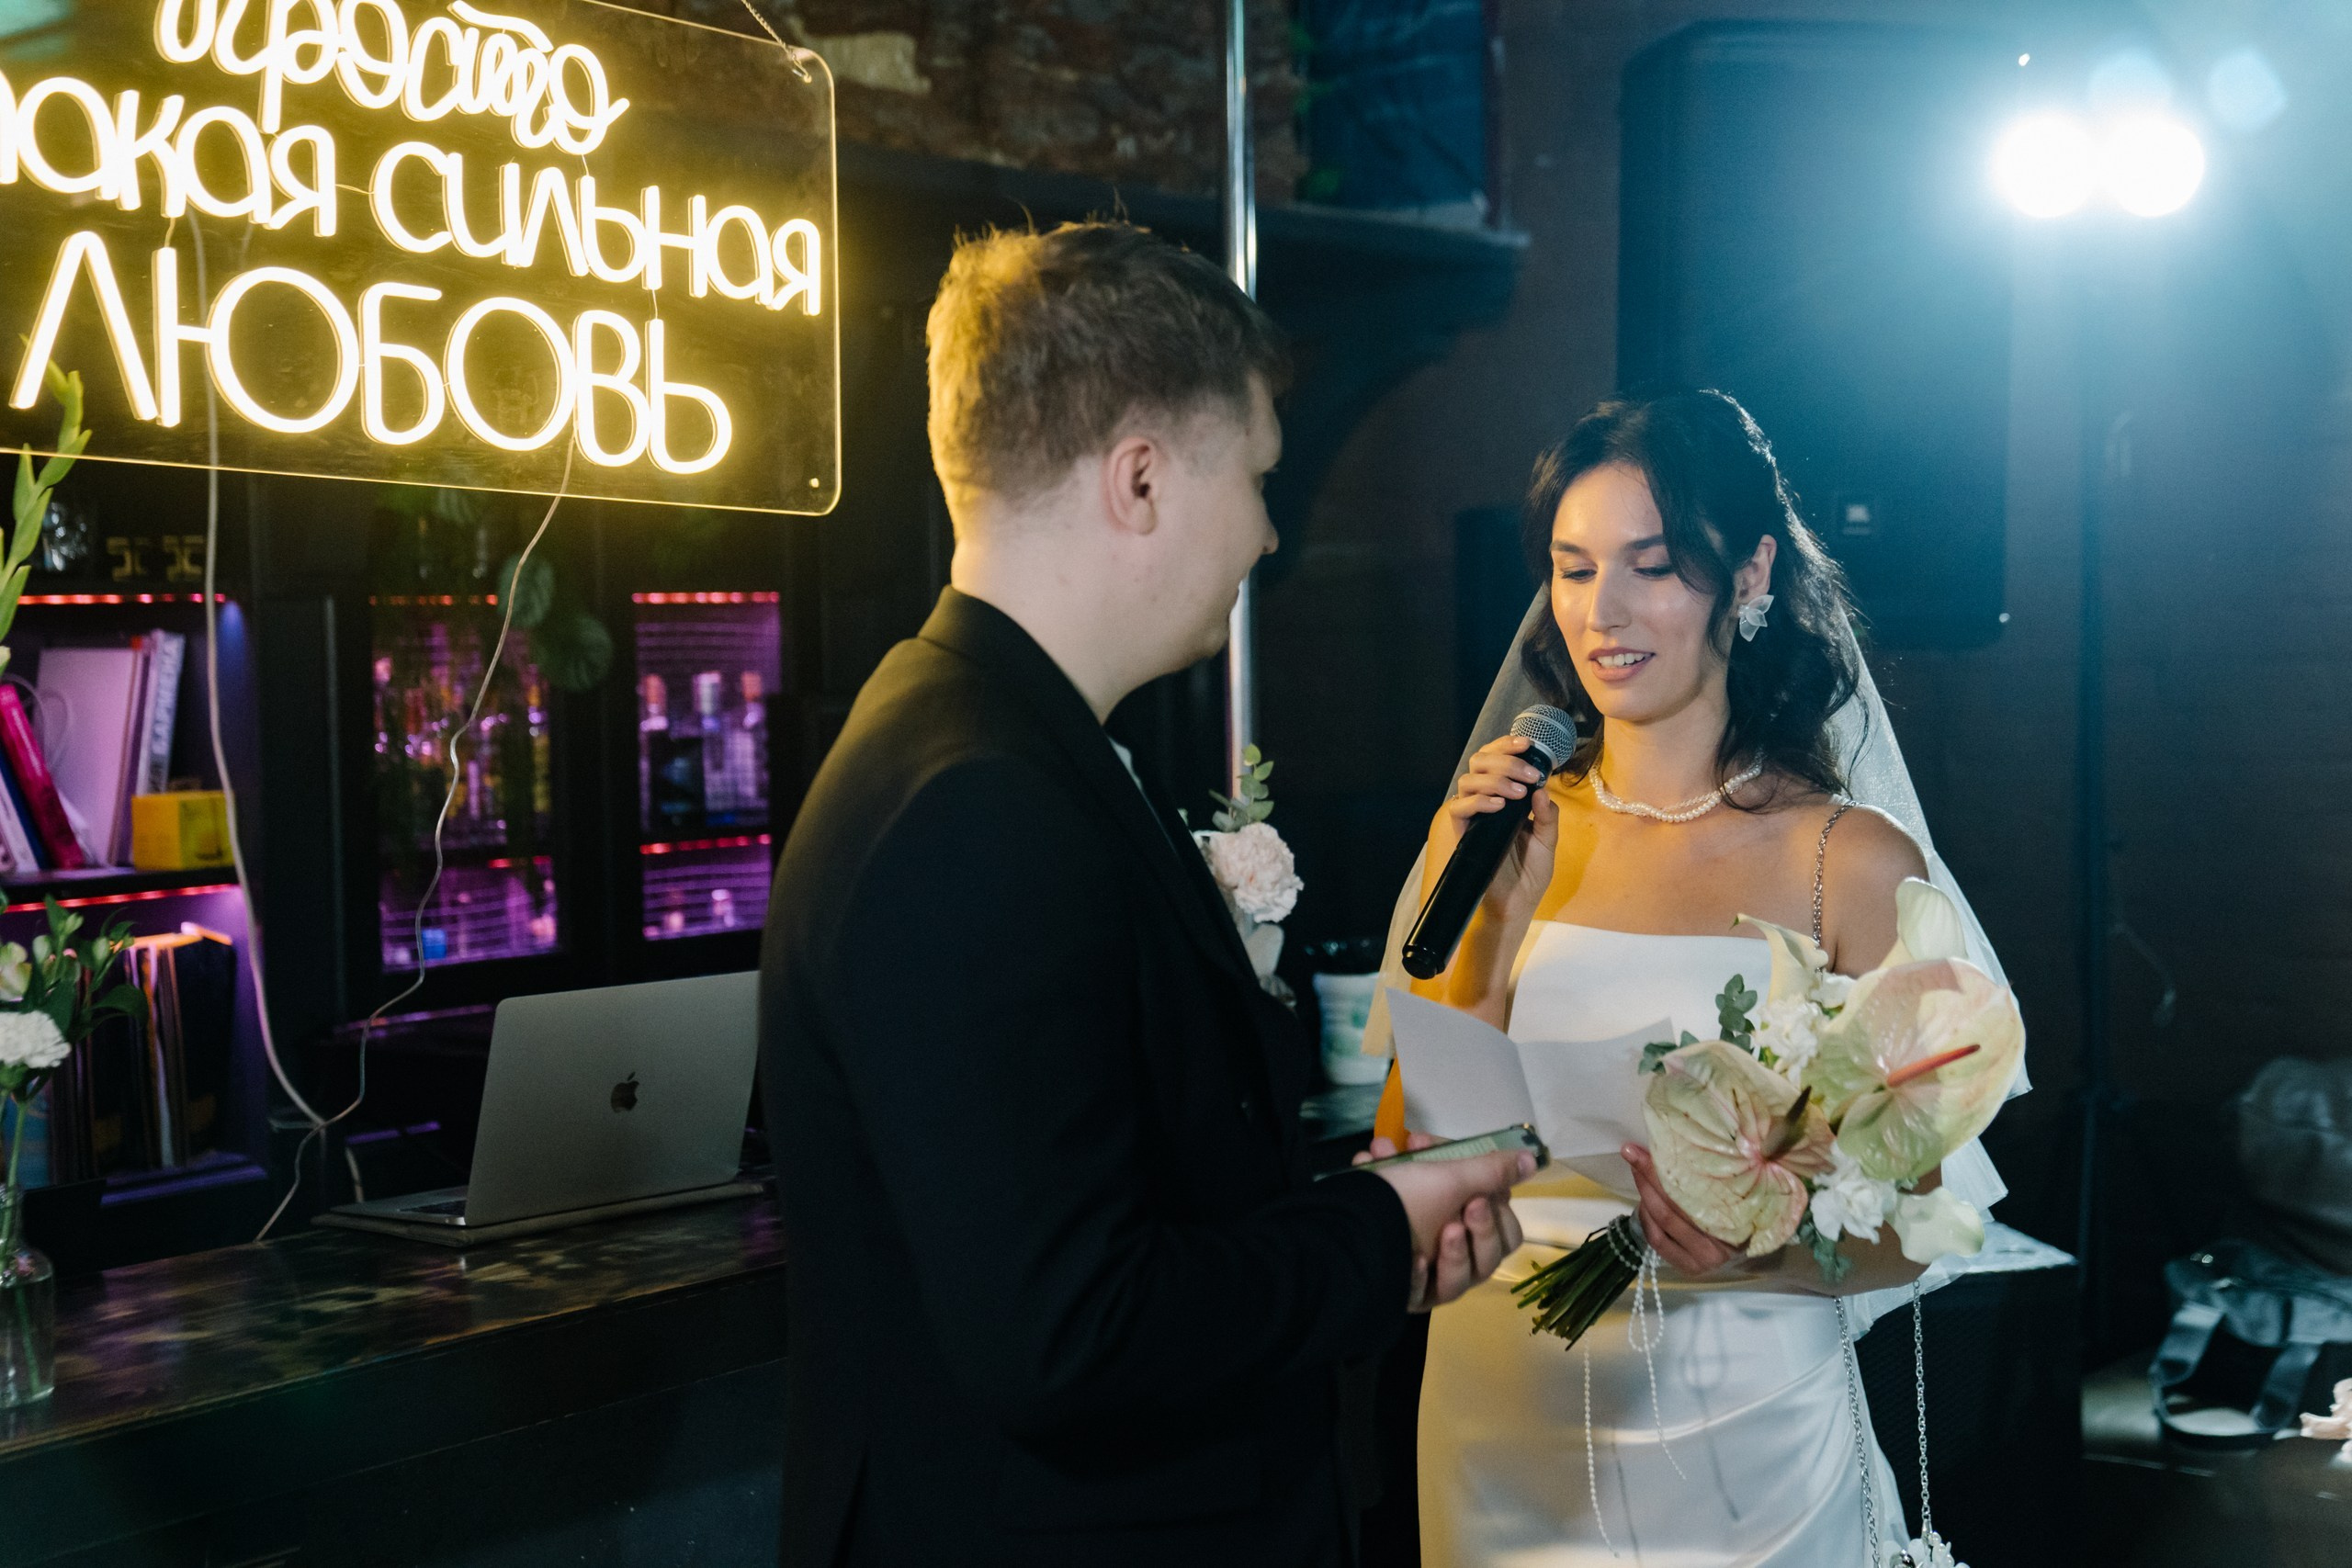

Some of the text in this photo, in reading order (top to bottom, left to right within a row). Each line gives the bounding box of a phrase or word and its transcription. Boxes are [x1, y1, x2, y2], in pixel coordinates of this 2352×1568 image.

[0, 70, 821, 316] акая сильная
[9, 230, 733, 475] ЛЮБОВЬ
